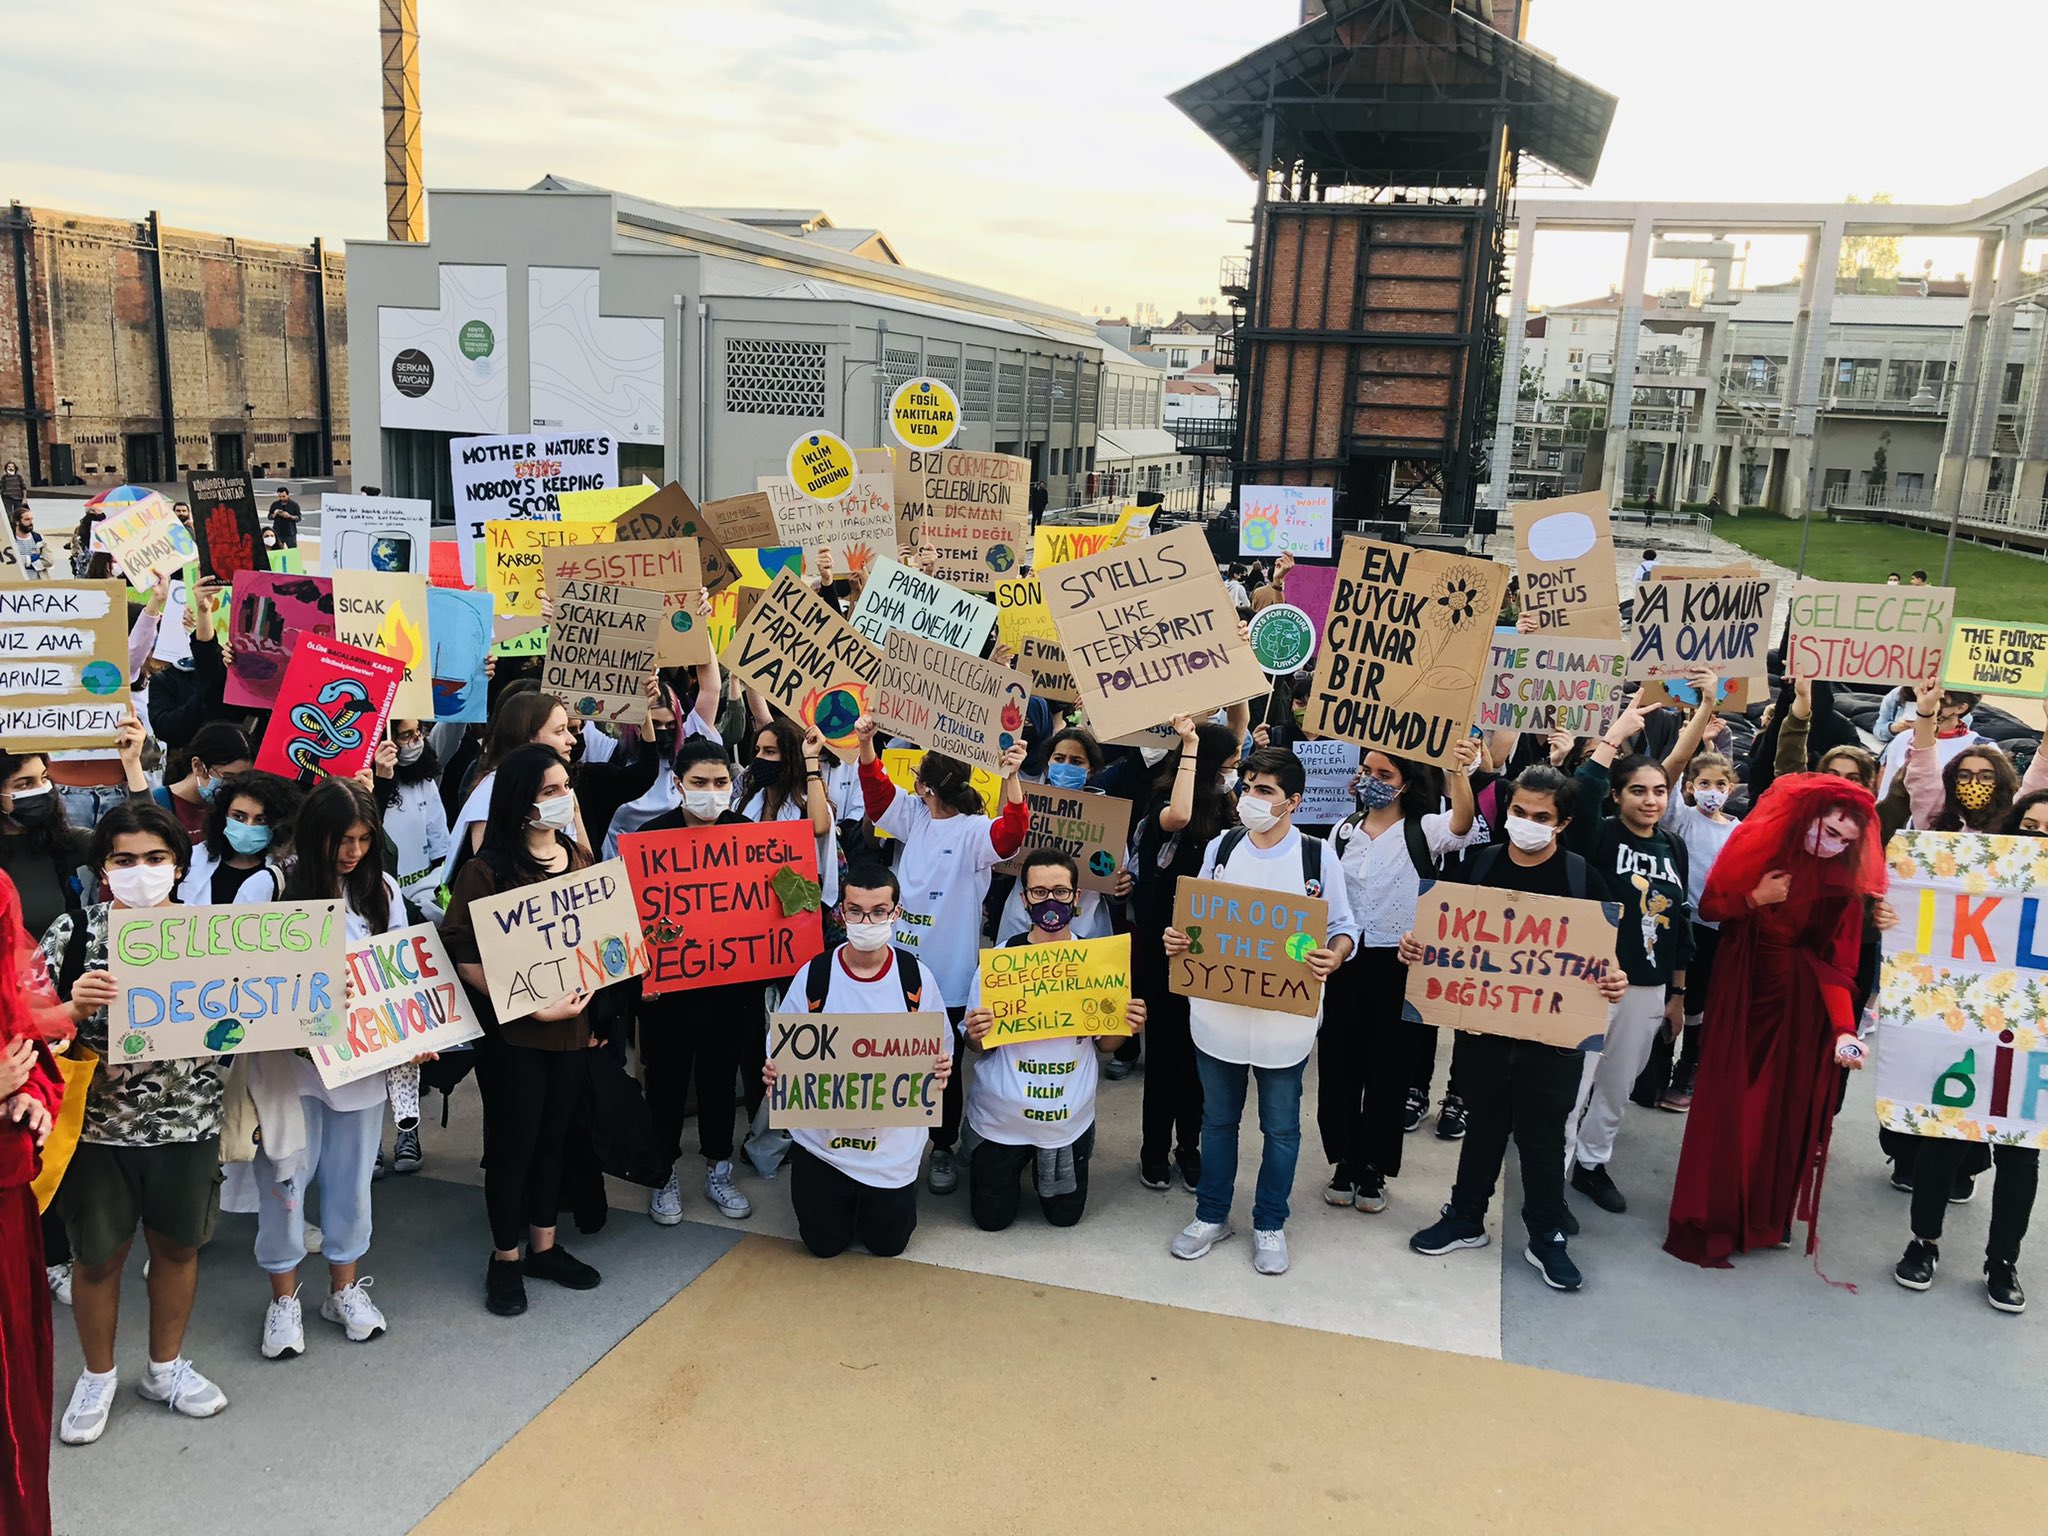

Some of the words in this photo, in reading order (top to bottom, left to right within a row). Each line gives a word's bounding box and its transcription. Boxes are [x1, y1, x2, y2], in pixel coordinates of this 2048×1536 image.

[396, 363, 430, 373] SERKAN
[397, 375, 430, 386] TAYCAN
[910, 393, 939, 406] FOSİL
[895, 408, 954, 422] YAKITLARA
[910, 423, 938, 436] VEDA
[462, 442, 537, 465] MOTHER
[545, 437, 610, 456] NATURE'S
[802, 445, 832, 467] İKLİM
[807, 466, 850, 493] DURUMU
[811, 457, 835, 477] ACİL
[947, 454, 1024, 482] GÖRMEZDEN
[217, 487, 245, 501] KURTAR
[466, 478, 536, 501] NOBODY'S
[543, 473, 605, 493] KEEPING
[859, 484, 872, 497] IS
[1282, 488, 1303, 499] The
[780, 522, 812, 537] THAN
[840, 514, 894, 529] IMAGINARY
[901, 502, 934, 521] AMA
[488, 527, 514, 549] YA
[921, 522, 968, 539] İKLİMİ
[972, 526, 1014, 542] DEĞİL
[497, 552, 543, 568] KARBO
[1061, 544, 1187, 610] SMELLS
[1527, 567, 1576, 590] DON'T
[339, 598, 385, 615] SICAK
[772, 575, 831, 636] İKLİM
[888, 570, 940, 606] PARAN
[950, 599, 979, 623] MI
[999, 582, 1042, 608] SON
[1334, 578, 1429, 629] BÜYÜK
[1525, 590, 1559, 612] LET
[1562, 585, 1587, 604] US
[1634, 583, 1669, 624] YA
[1681, 581, 1771, 624] KÖMÜR
[557, 603, 647, 632] SICAKLAR
[866, 591, 905, 624] DAHA
[912, 607, 972, 649] ÖNEMLİ
[1097, 600, 1155, 631] LIKE
[1538, 608, 1570, 629] DIE
[1792, 594, 1945, 635] GELECEK
[36, 633, 83, 651] AMA
[341, 632, 385, 648] HAVA
[556, 623, 600, 646] YENİ
[1251, 617, 1267, 650] FRIDAYS
[1265, 610, 1282, 620] FOR
[1283, 610, 1309, 633] FUTURE
[1328, 615, 1417, 666] ÇINAR
[1630, 623, 1664, 662] YA
[1676, 621, 1759, 662] ÖMÜR
[1961, 628, 1995, 645] THE
[1999, 630, 2048, 651] FUTURE
[752, 603, 836, 688] FARKINA
[2003, 649, 2035, 668] OUR
[738, 633, 803, 707] VAR
[888, 631, 918, 665] BEN
[923, 648, 1003, 699] GELECEĞİMİ
[1097, 643, 1230, 699] POLLUTION
[1272, 652, 1301, 668] TURKEY
[1490, 646, 1530, 669] THE
[1536, 650, 1625, 677] CLIMATE
[1973, 663, 2022, 685] HANDS
[548, 667, 639, 695] OLMASIN
[1328, 653, 1385, 701] BİR
[1491, 673, 1515, 700] IS
[1518, 678, 1623, 703] CHANGING
[883, 664, 990, 726] DÜŞÜNMEKTEN
[879, 691, 931, 730] BIKTIM
[1481, 702, 1528, 730] WHY
[1296, 743, 1344, 755] SADECE
[640, 836, 738, 878] İKLİMİ
[745, 838, 803, 864] DEĞİL
[1616, 843, 1683, 890] UCLA
[492, 893, 542, 935] WE
[550, 875, 616, 917] NEED
[641, 874, 770, 922] SİSTEMİ
[1190, 894, 1309, 933] UPROOT
[1437, 901, 1570, 949] İKLİMİ
[117, 906, 335, 967] GELECEĞİ
[537, 913, 581, 950] TO
[1216, 933, 1274, 961] THE
[1422, 944, 1502, 973] DEĞİL
[507, 957, 567, 1010] ACT
[575, 931, 651, 993] NOW
[992, 949, 1088, 974] OLMAYAN
[1181, 959, 1310, 1001] SYSTEM
[992, 999, 1027, 1019] BİR
[1426, 977, 1564, 1015] DEĞİŞTİR
[997, 1010, 1075, 1035] NESİLİZ
[771, 1023, 839, 1061] YOK
[852, 1037, 941, 1058] OLMADAN
[1018, 1059, 1078, 1075] KÜRESEL
[771, 1072, 886, 1111] HAREKETE
[893, 1072, 938, 1116] GEÇ
[1027, 1085, 1065, 1100] İKLİM
[1023, 1103, 1070, 1121] GREVİ
[831, 1136, 877, 1152] GREVİ
